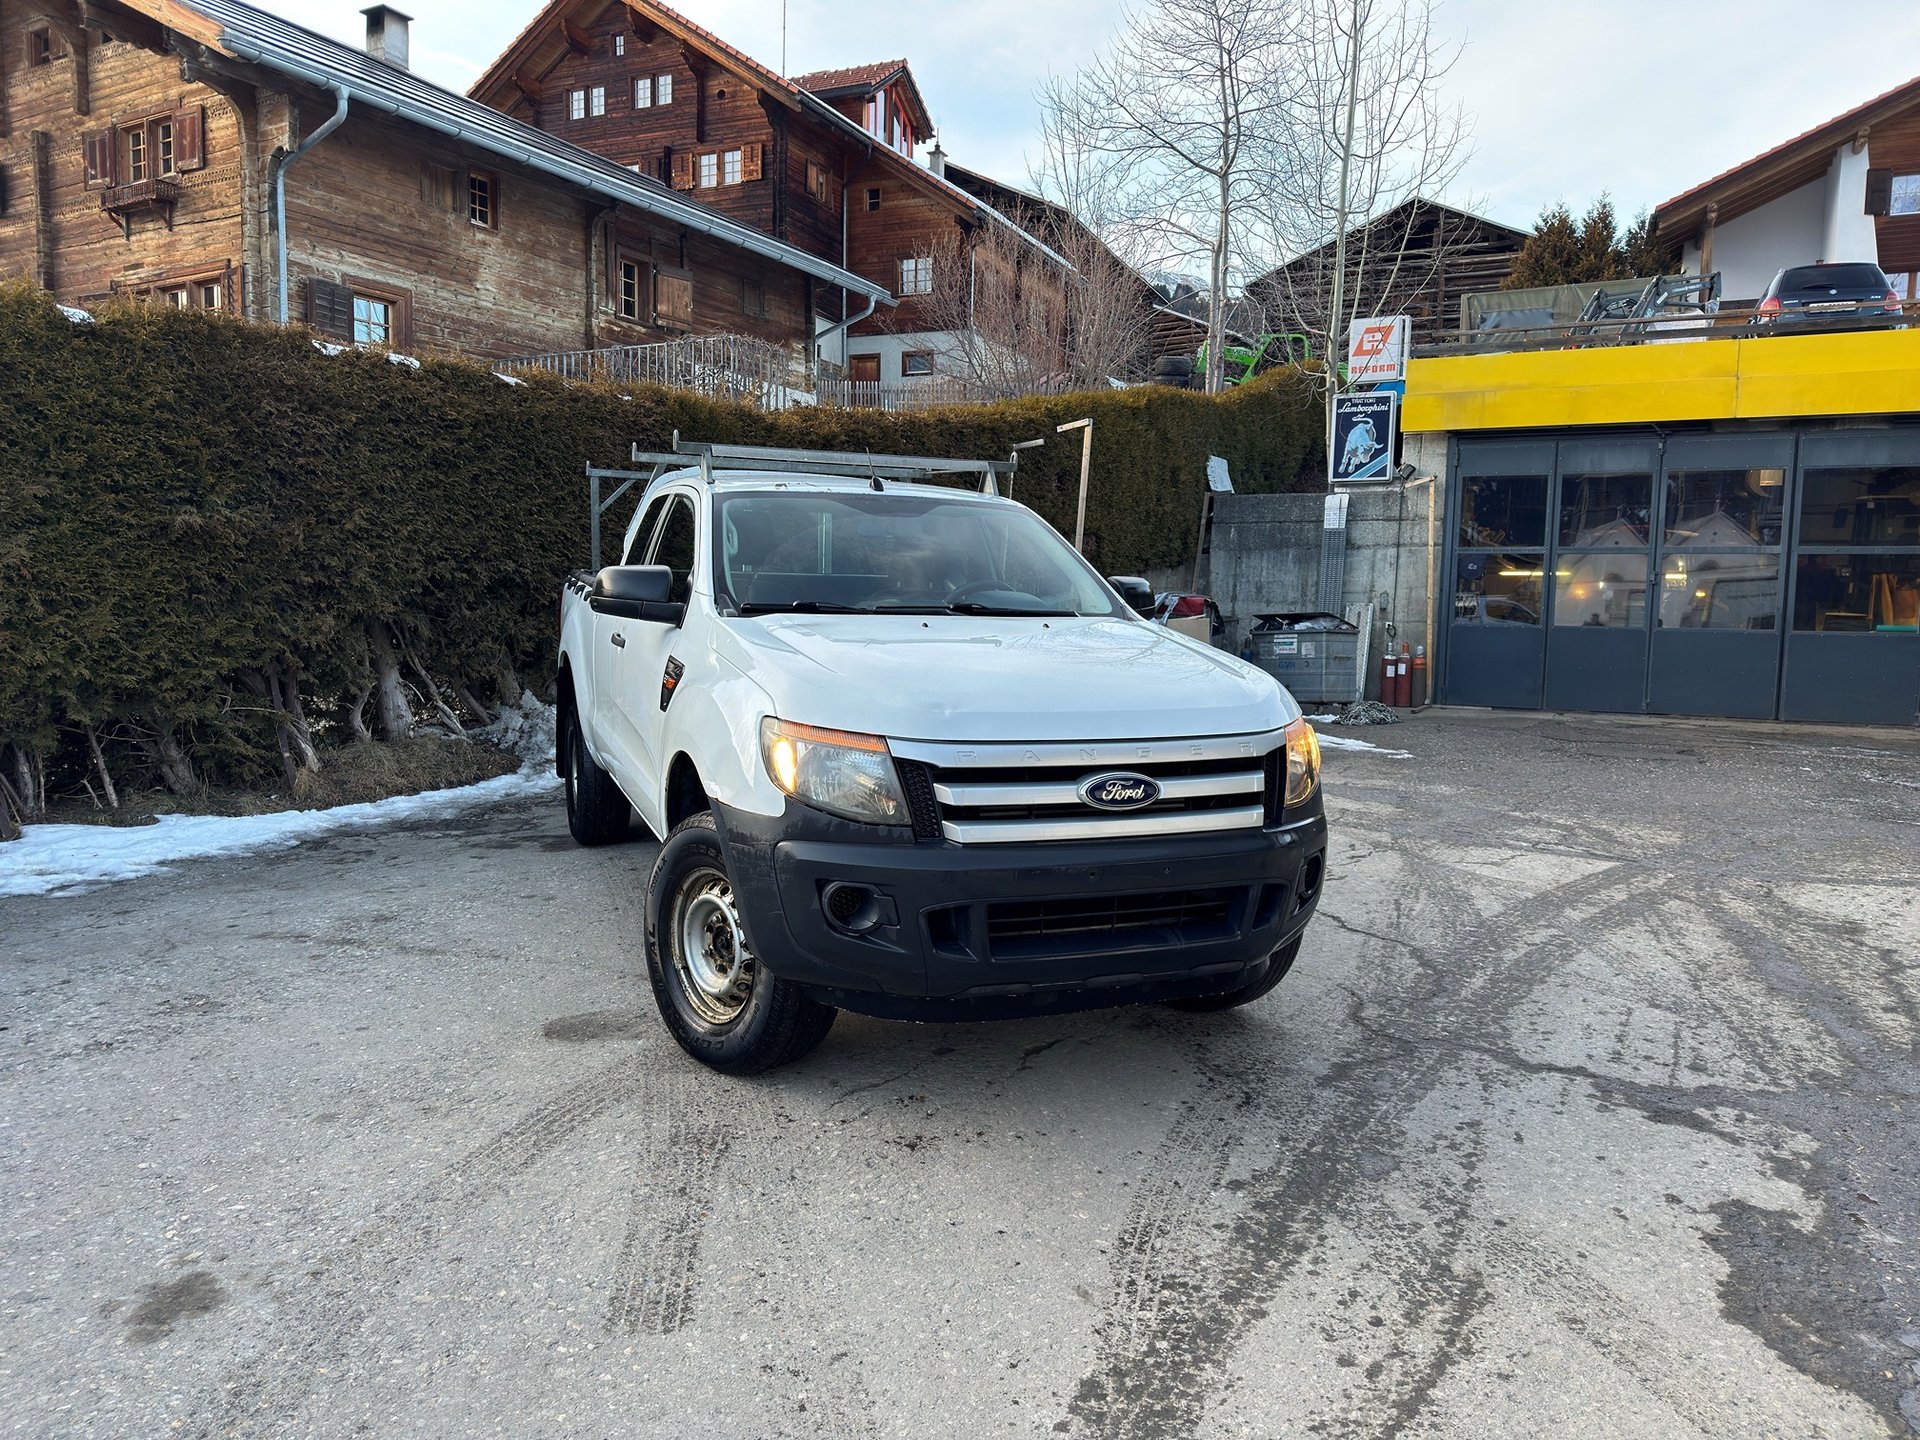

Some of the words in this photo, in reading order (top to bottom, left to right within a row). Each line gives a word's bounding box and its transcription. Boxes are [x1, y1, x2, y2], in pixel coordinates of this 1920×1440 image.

[1351, 364, 1396, 374] REFORM
[1338, 402, 1390, 414] Lamborghini
[956, 742, 1254, 763] RANGER
[1102, 780, 1145, 801] Ford
